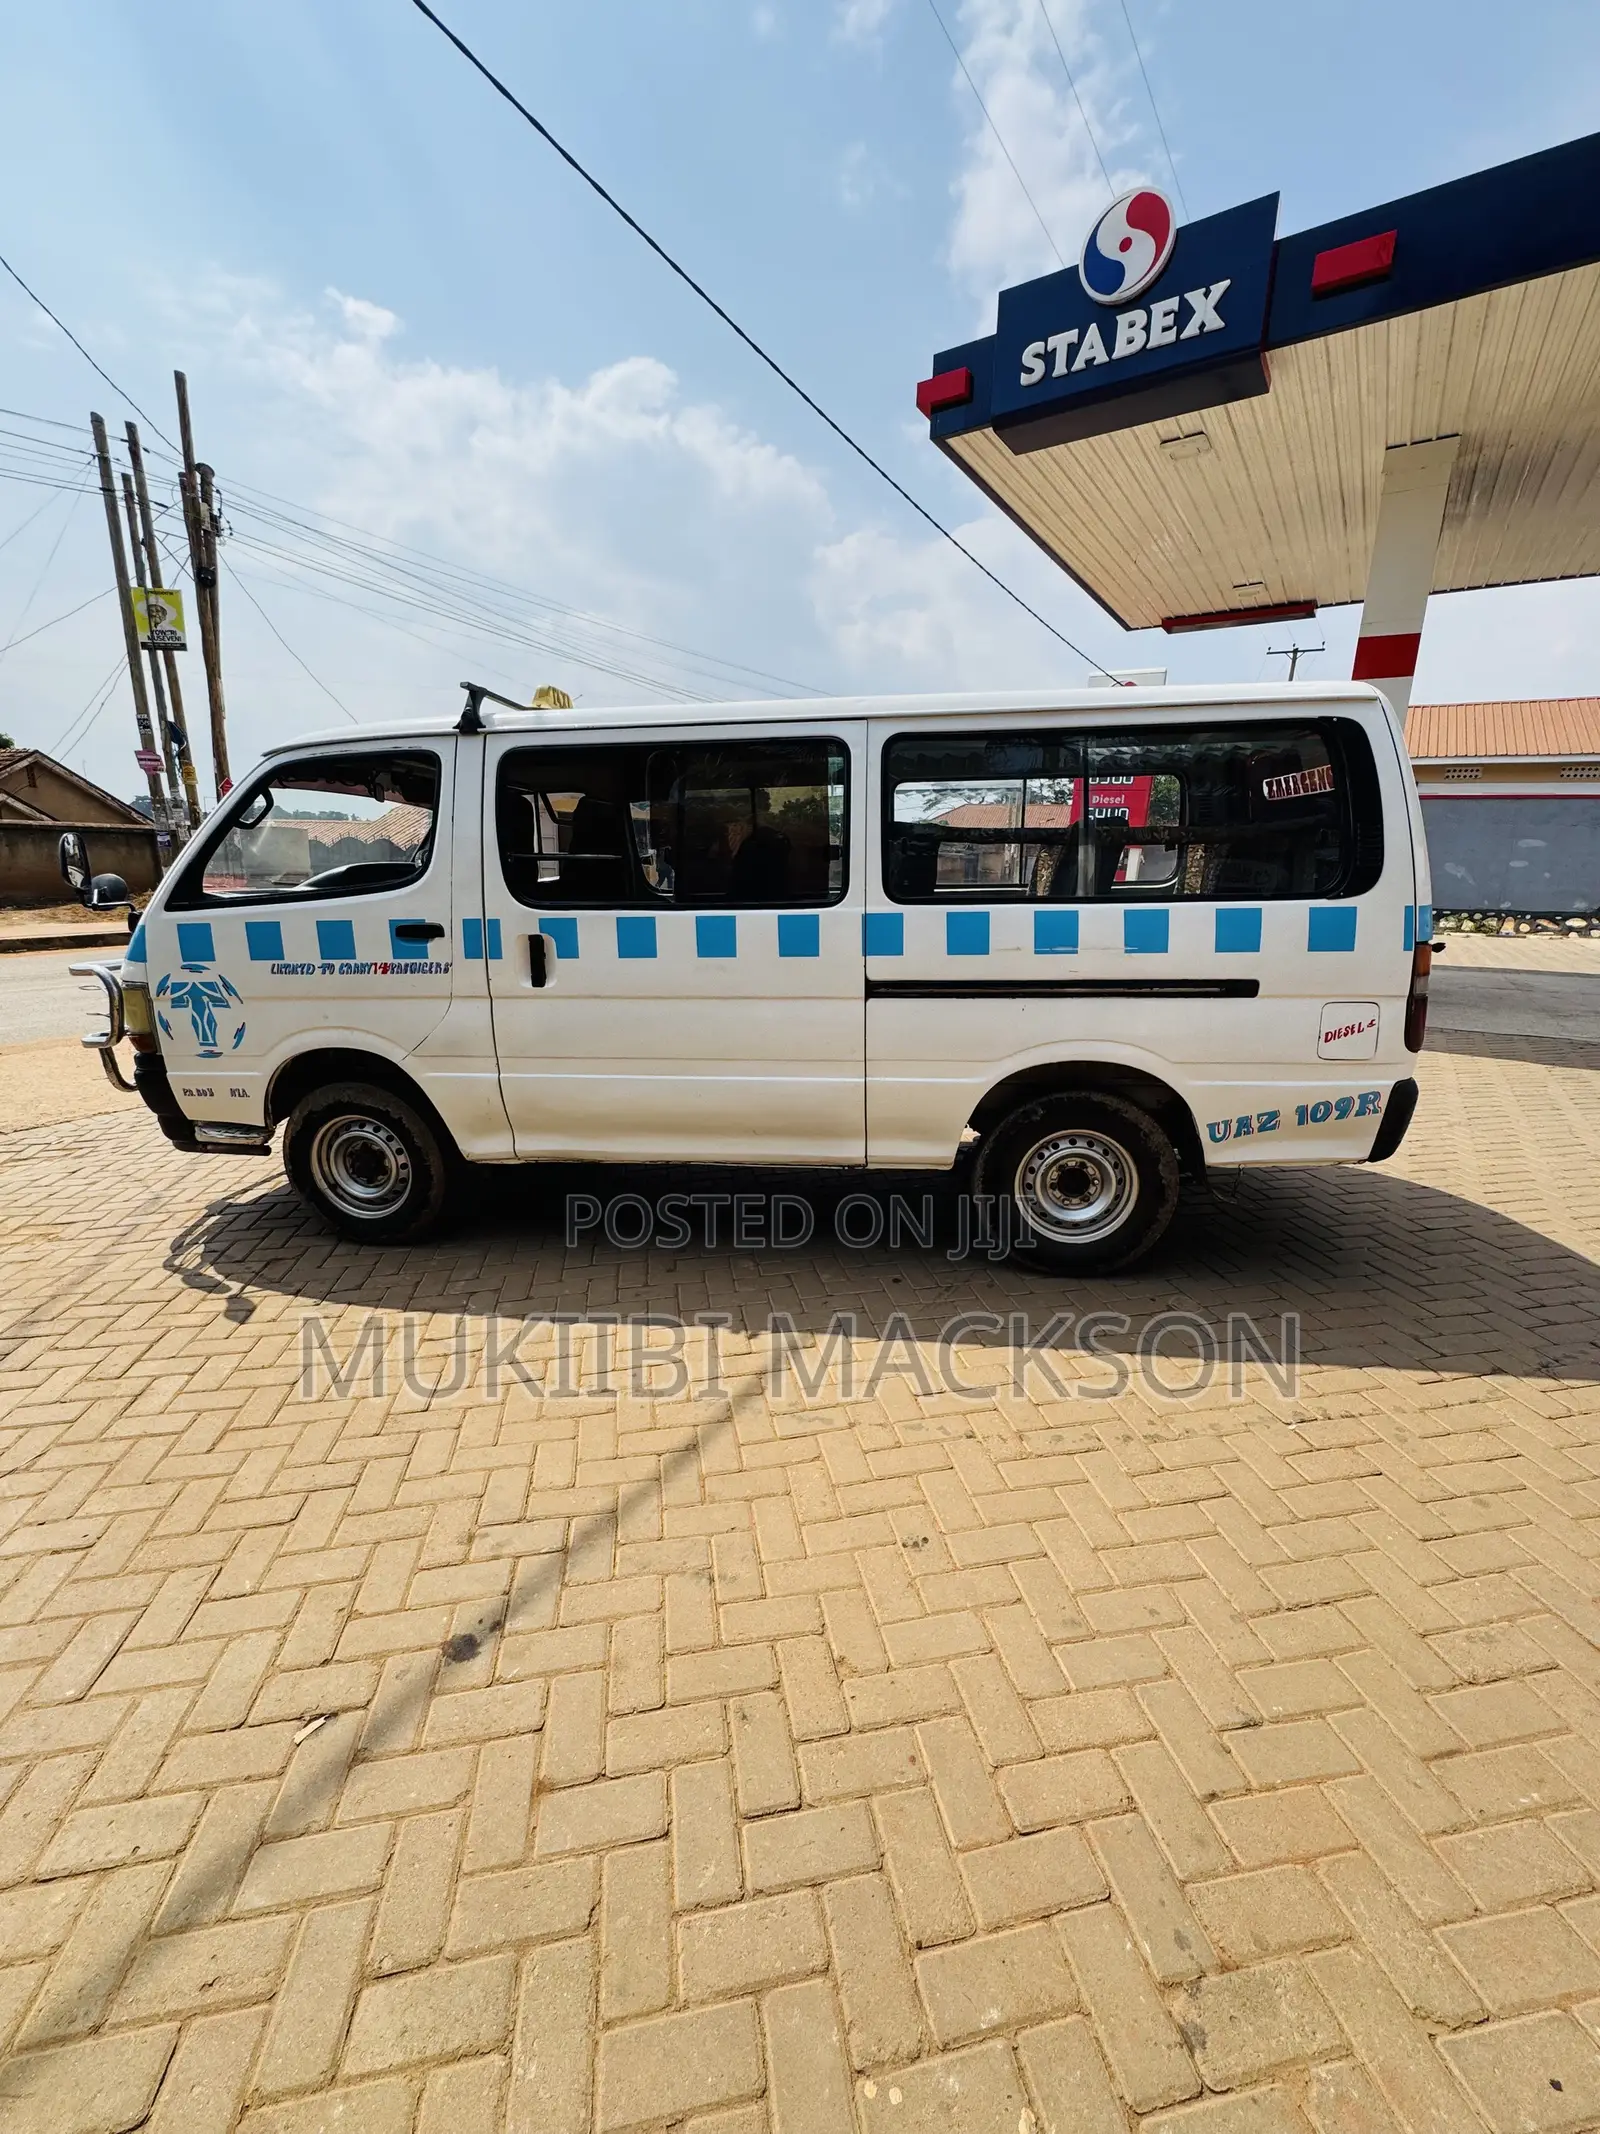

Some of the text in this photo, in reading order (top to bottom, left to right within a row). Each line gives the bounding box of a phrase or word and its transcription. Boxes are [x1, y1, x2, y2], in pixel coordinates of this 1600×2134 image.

[1020, 279, 1231, 386] STABEX
[1091, 794, 1125, 804] Diesel
[1264, 766, 1334, 799] EMERGENC
[1324, 1021, 1364, 1043] DIESEL
[1206, 1091, 1382, 1143] UAZ 109R
